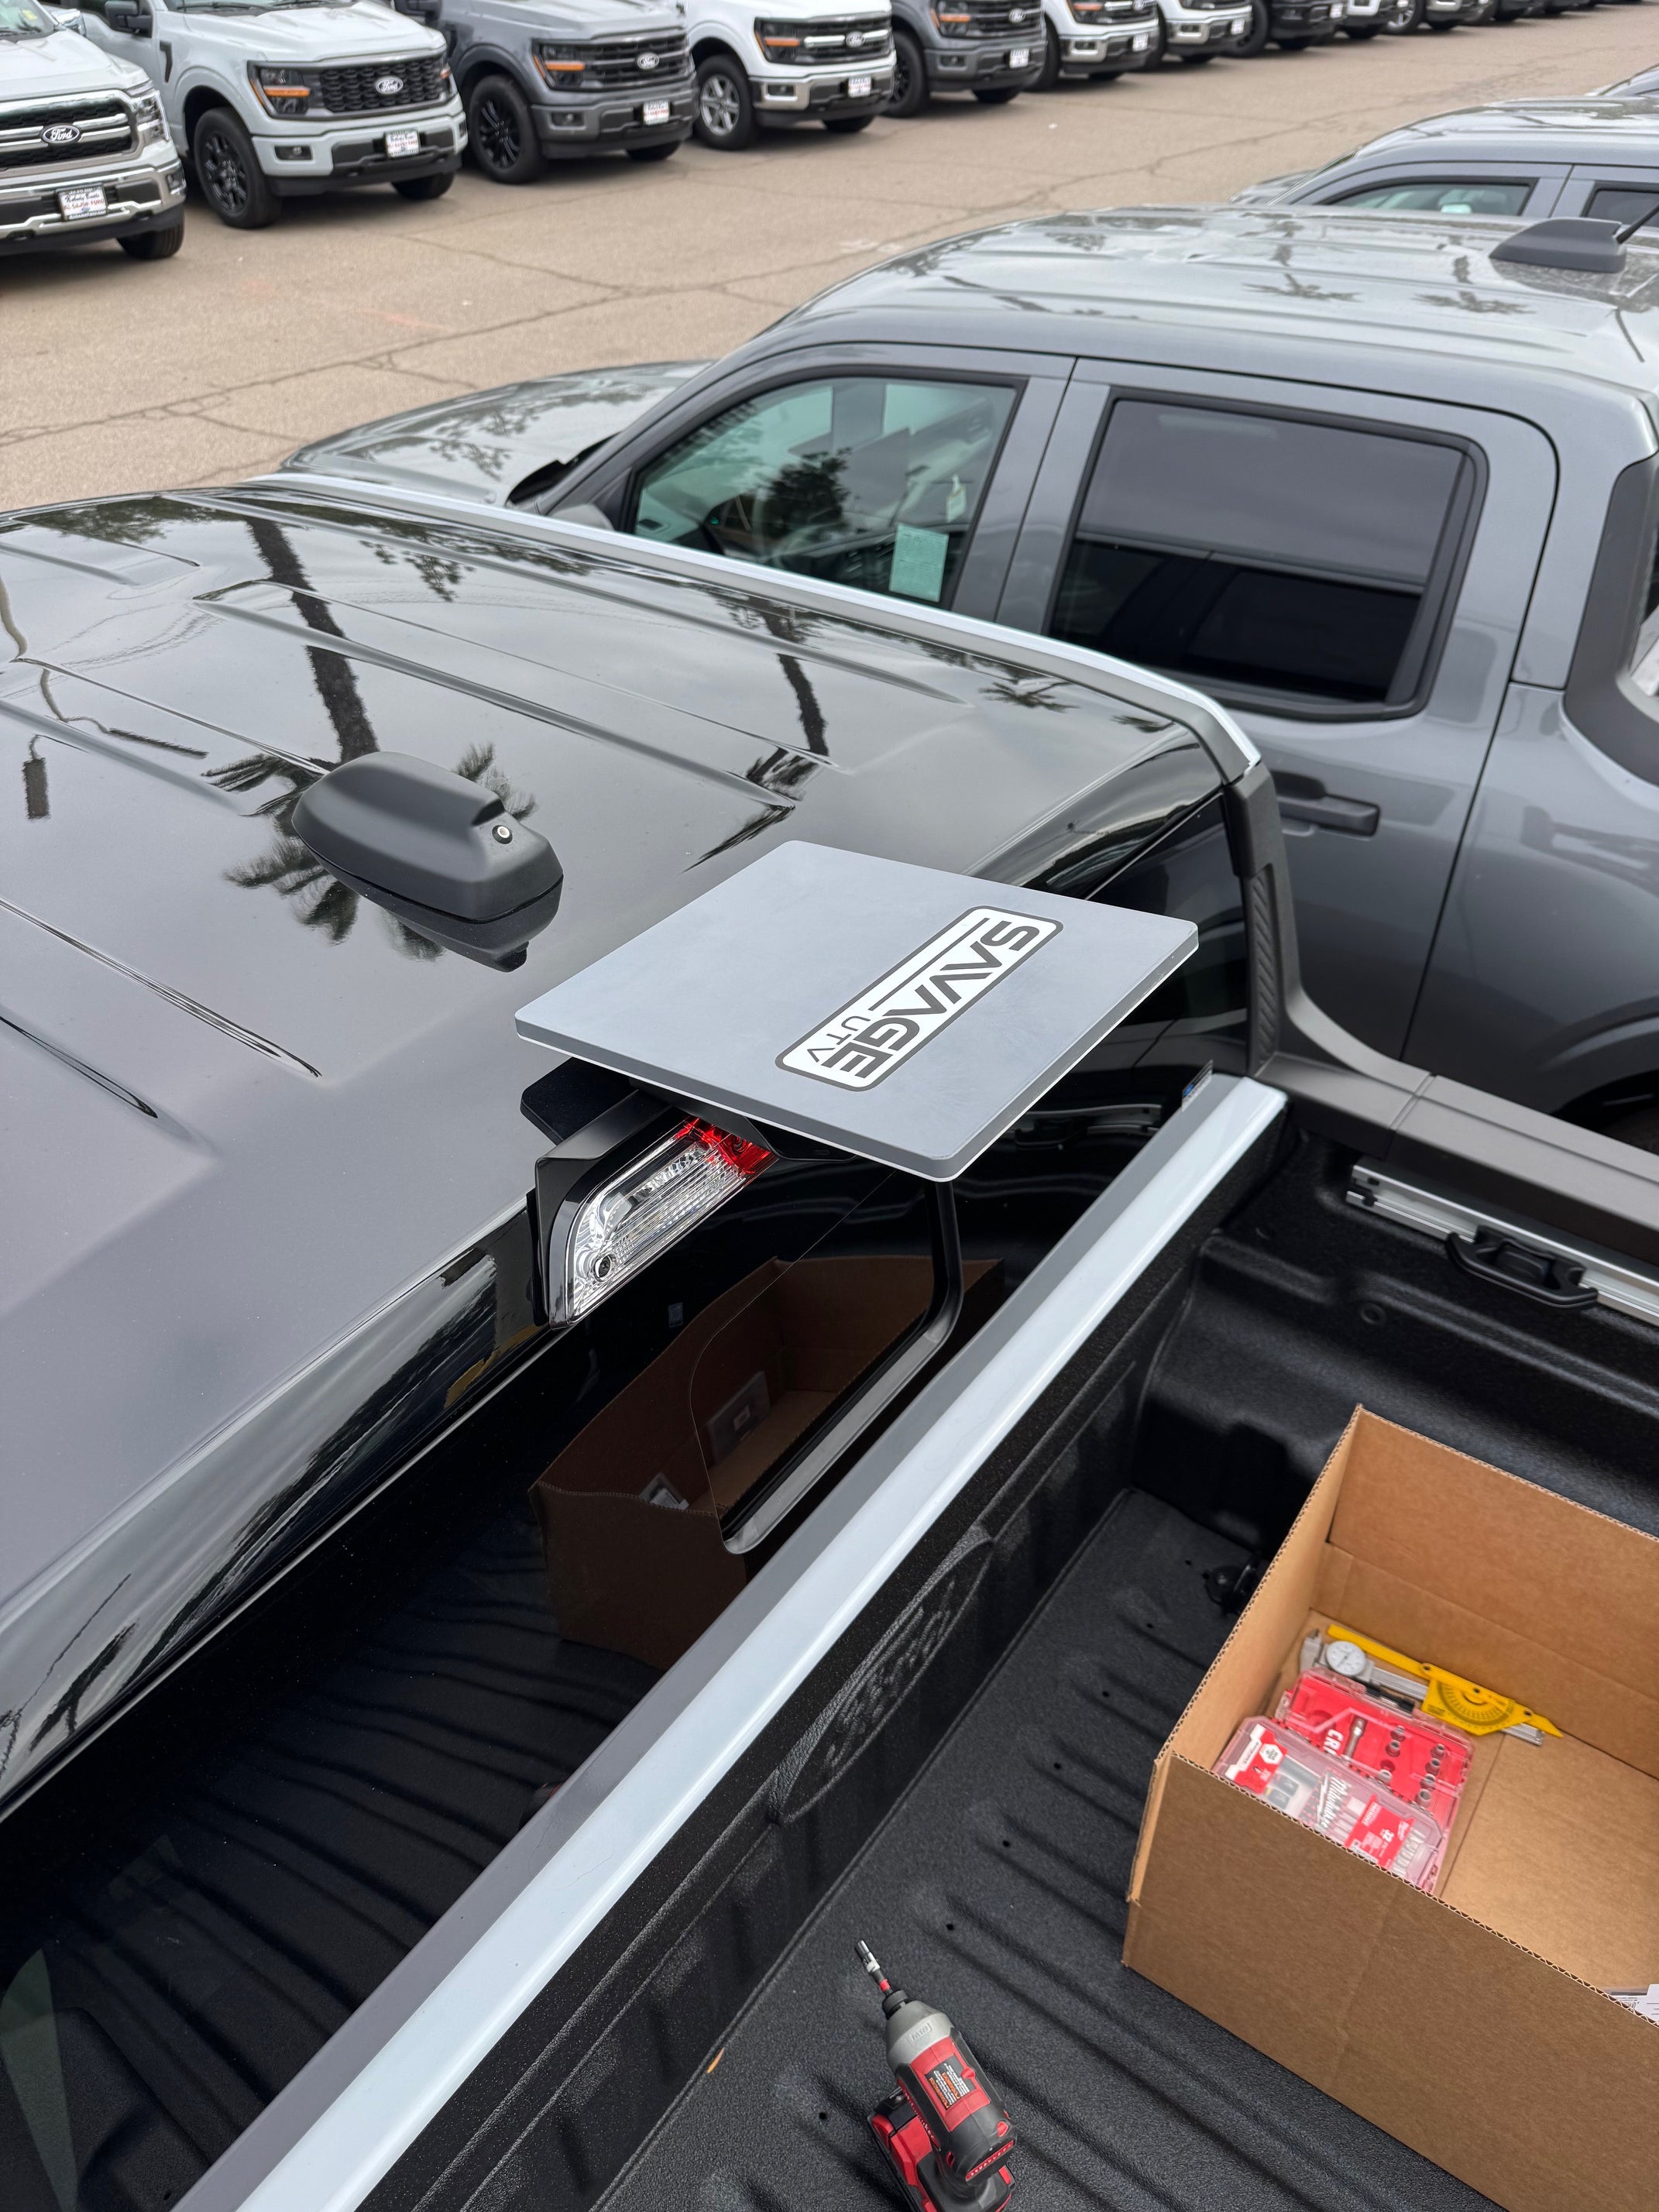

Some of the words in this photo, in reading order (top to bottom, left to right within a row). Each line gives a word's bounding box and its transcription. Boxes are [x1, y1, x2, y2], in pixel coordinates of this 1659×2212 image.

[50, 127, 73, 141] Ford
[821, 920, 1040, 1078] SAVAGE
[806, 1015, 871, 1063] UTV
[911, 2025, 929, 2040] M18
